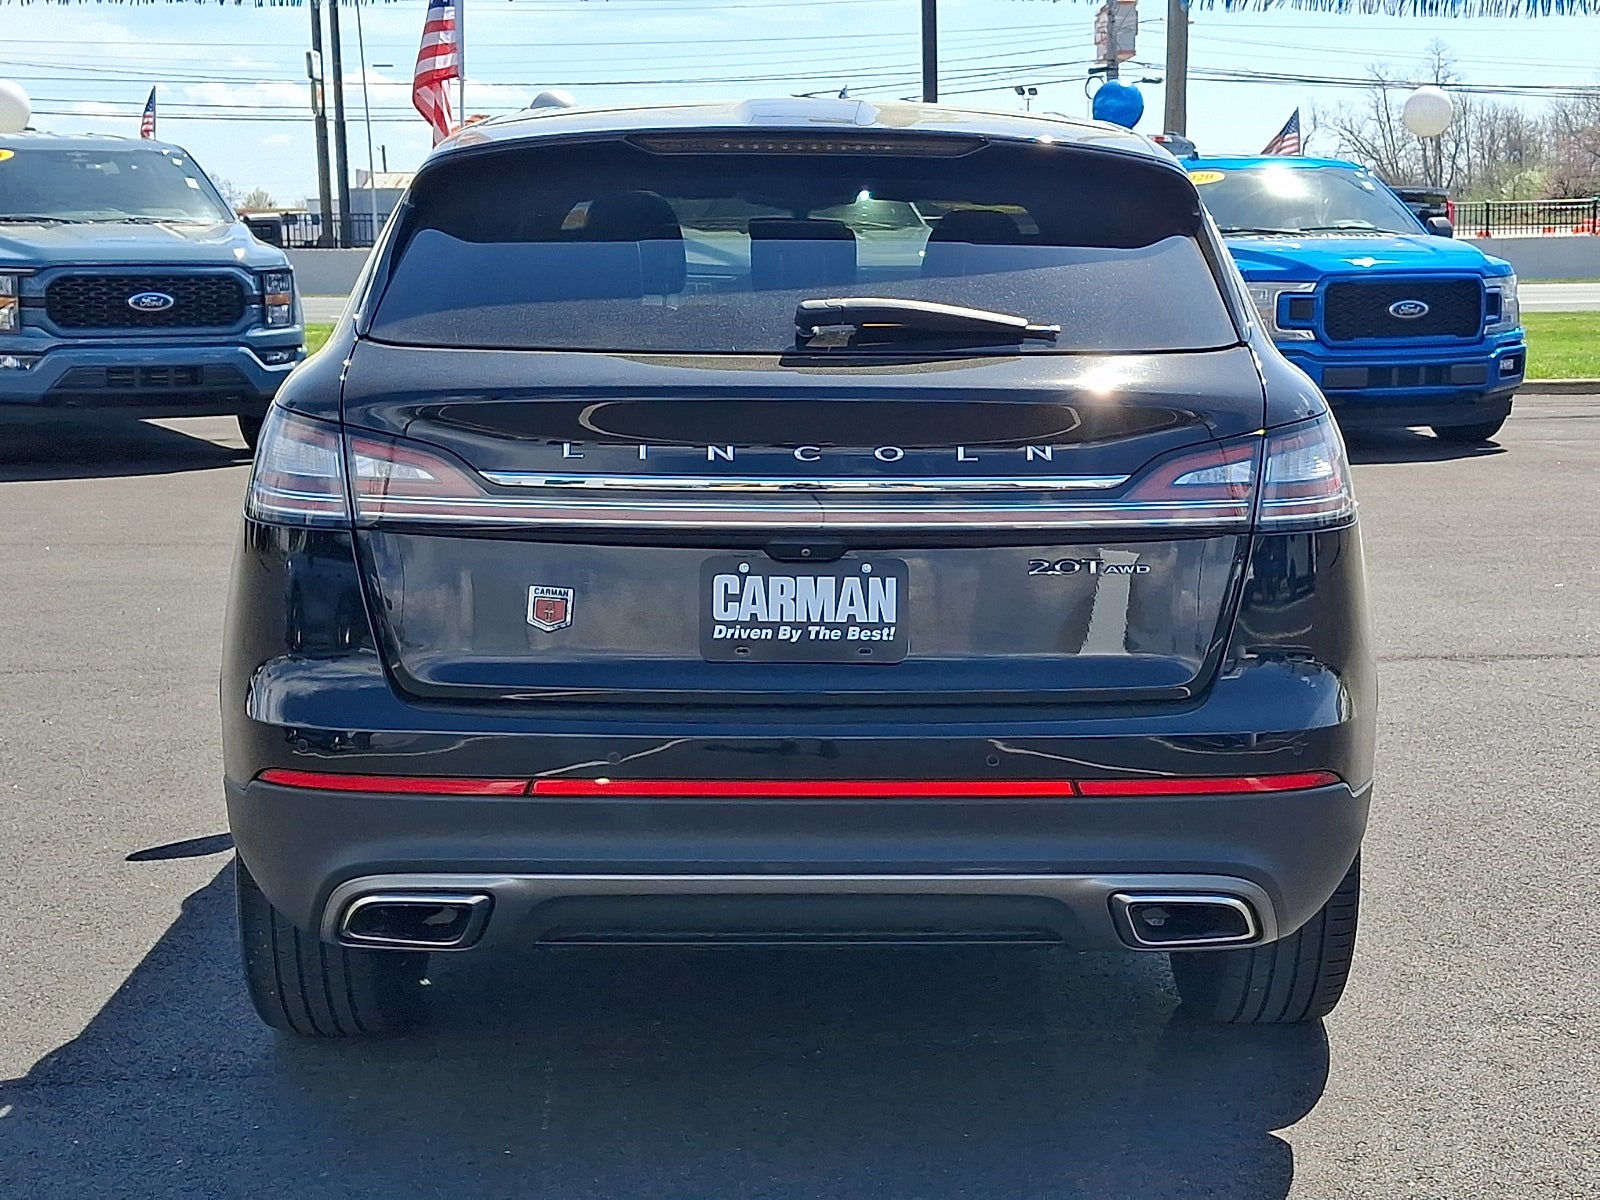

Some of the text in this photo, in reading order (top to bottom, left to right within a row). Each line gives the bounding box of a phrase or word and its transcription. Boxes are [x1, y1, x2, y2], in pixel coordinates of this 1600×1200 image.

[139, 295, 164, 307] Ford
[562, 443, 1053, 461] LINCOLN
[1104, 563, 1152, 575] AWD
[533, 587, 569, 597] CARMAN
[713, 574, 897, 623] CARMAN
[713, 625, 896, 643] Driven By The Best!
